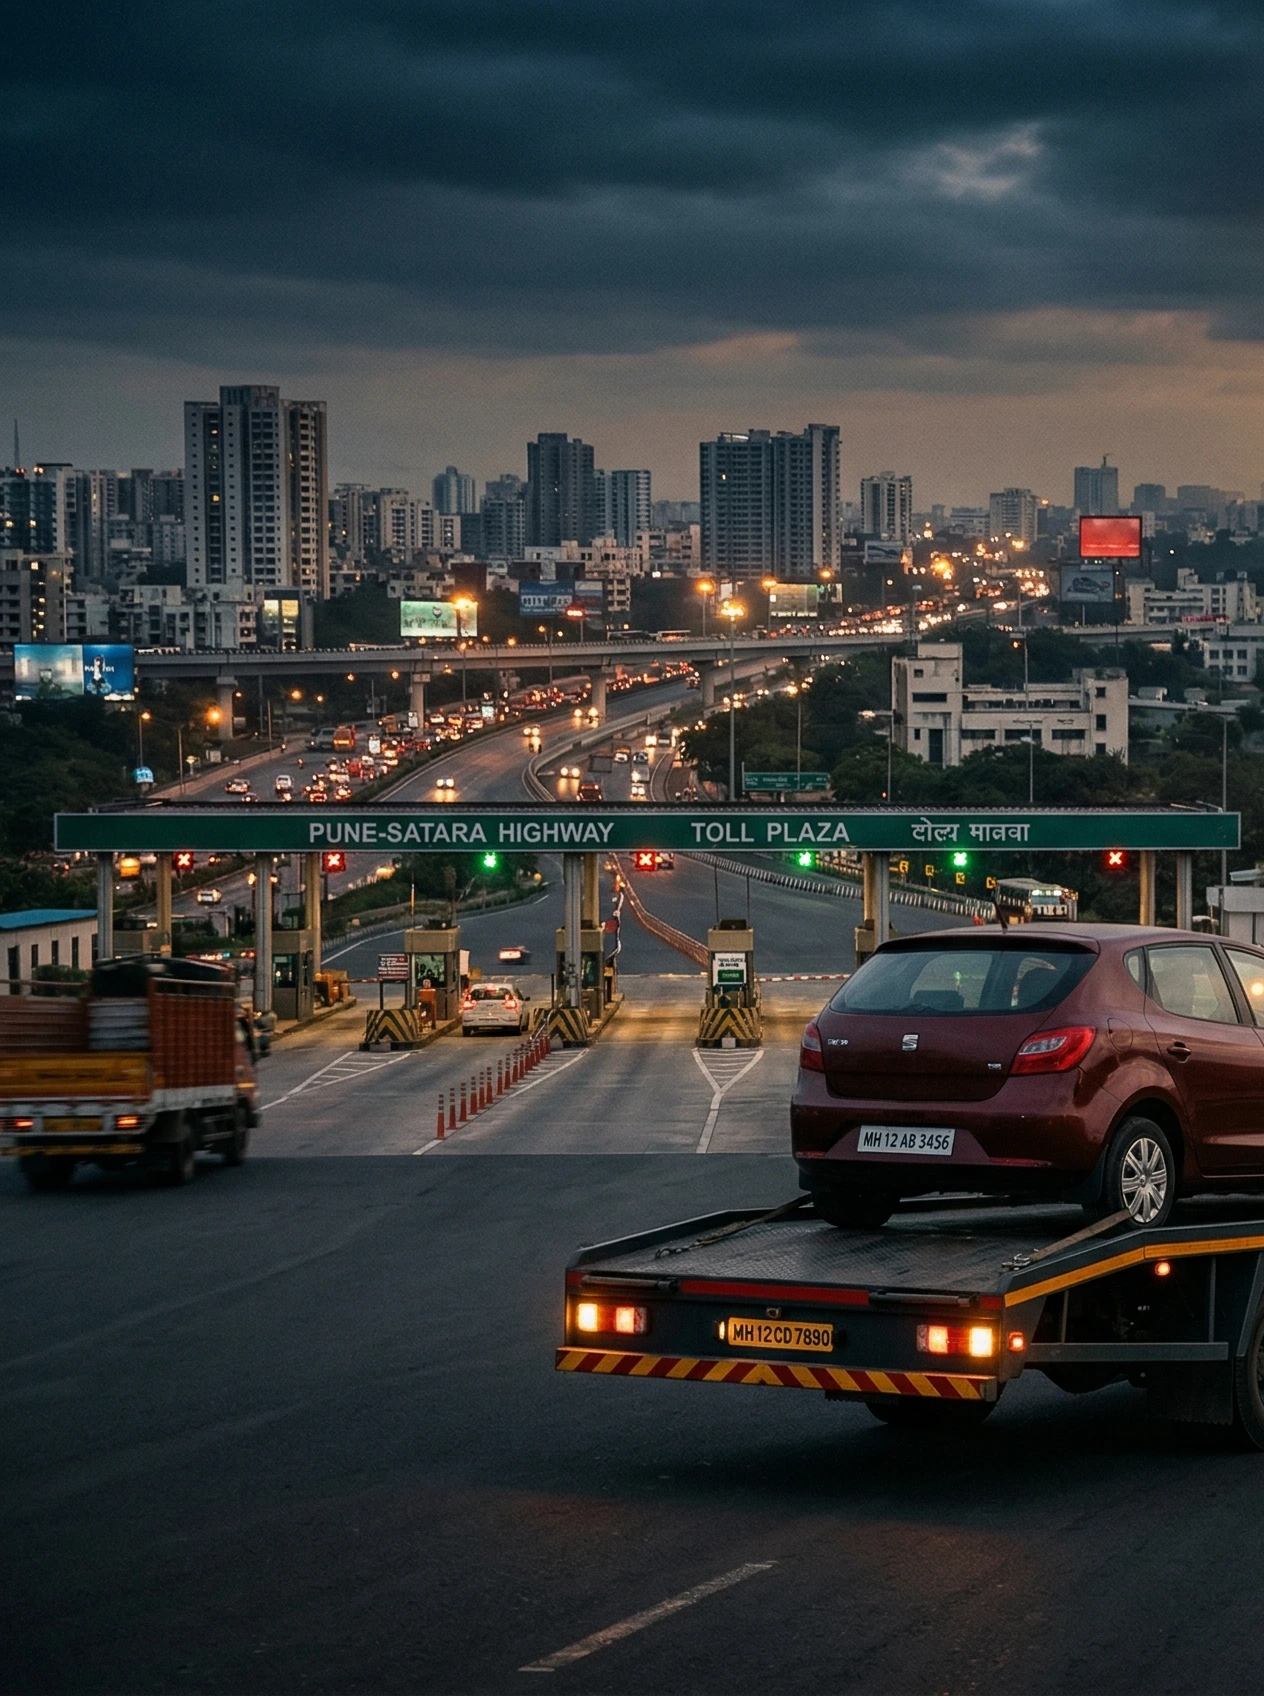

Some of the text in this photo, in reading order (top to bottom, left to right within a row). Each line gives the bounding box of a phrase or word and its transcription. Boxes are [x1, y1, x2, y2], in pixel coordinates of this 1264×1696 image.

[309, 822, 851, 843] PUNE-SATARA HIGHWAY TOLL PLAZA
[863, 1132, 882, 1147] MH
[885, 1133, 898, 1148] 12
[900, 1134, 916, 1149] AB
